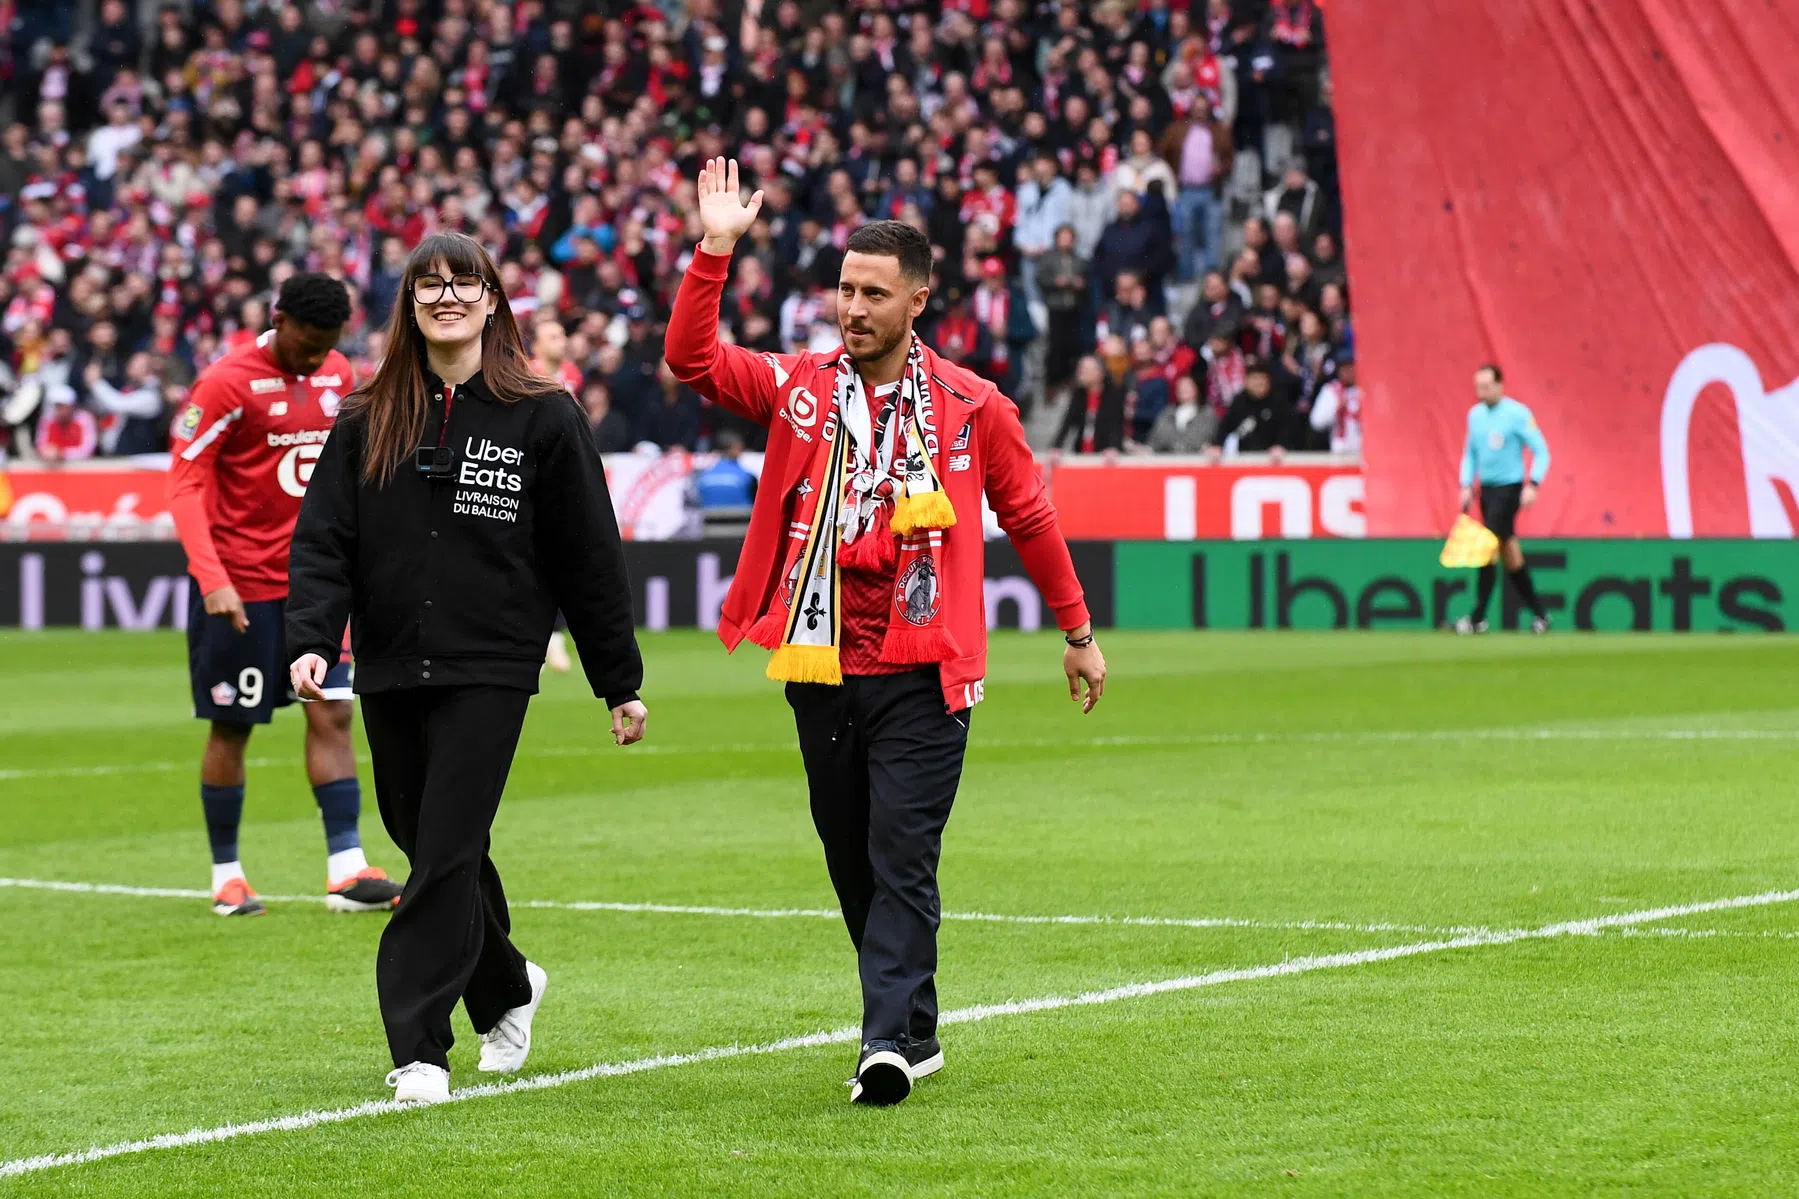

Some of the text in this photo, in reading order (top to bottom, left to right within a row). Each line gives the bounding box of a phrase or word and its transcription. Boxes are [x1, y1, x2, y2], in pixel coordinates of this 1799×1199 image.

[465, 436, 524, 466] Uber
[459, 461, 521, 491] Eats
[453, 502, 517, 522] DU BALLON
[455, 490, 519, 510] LIVRAISON
[238, 667, 264, 708] 9
